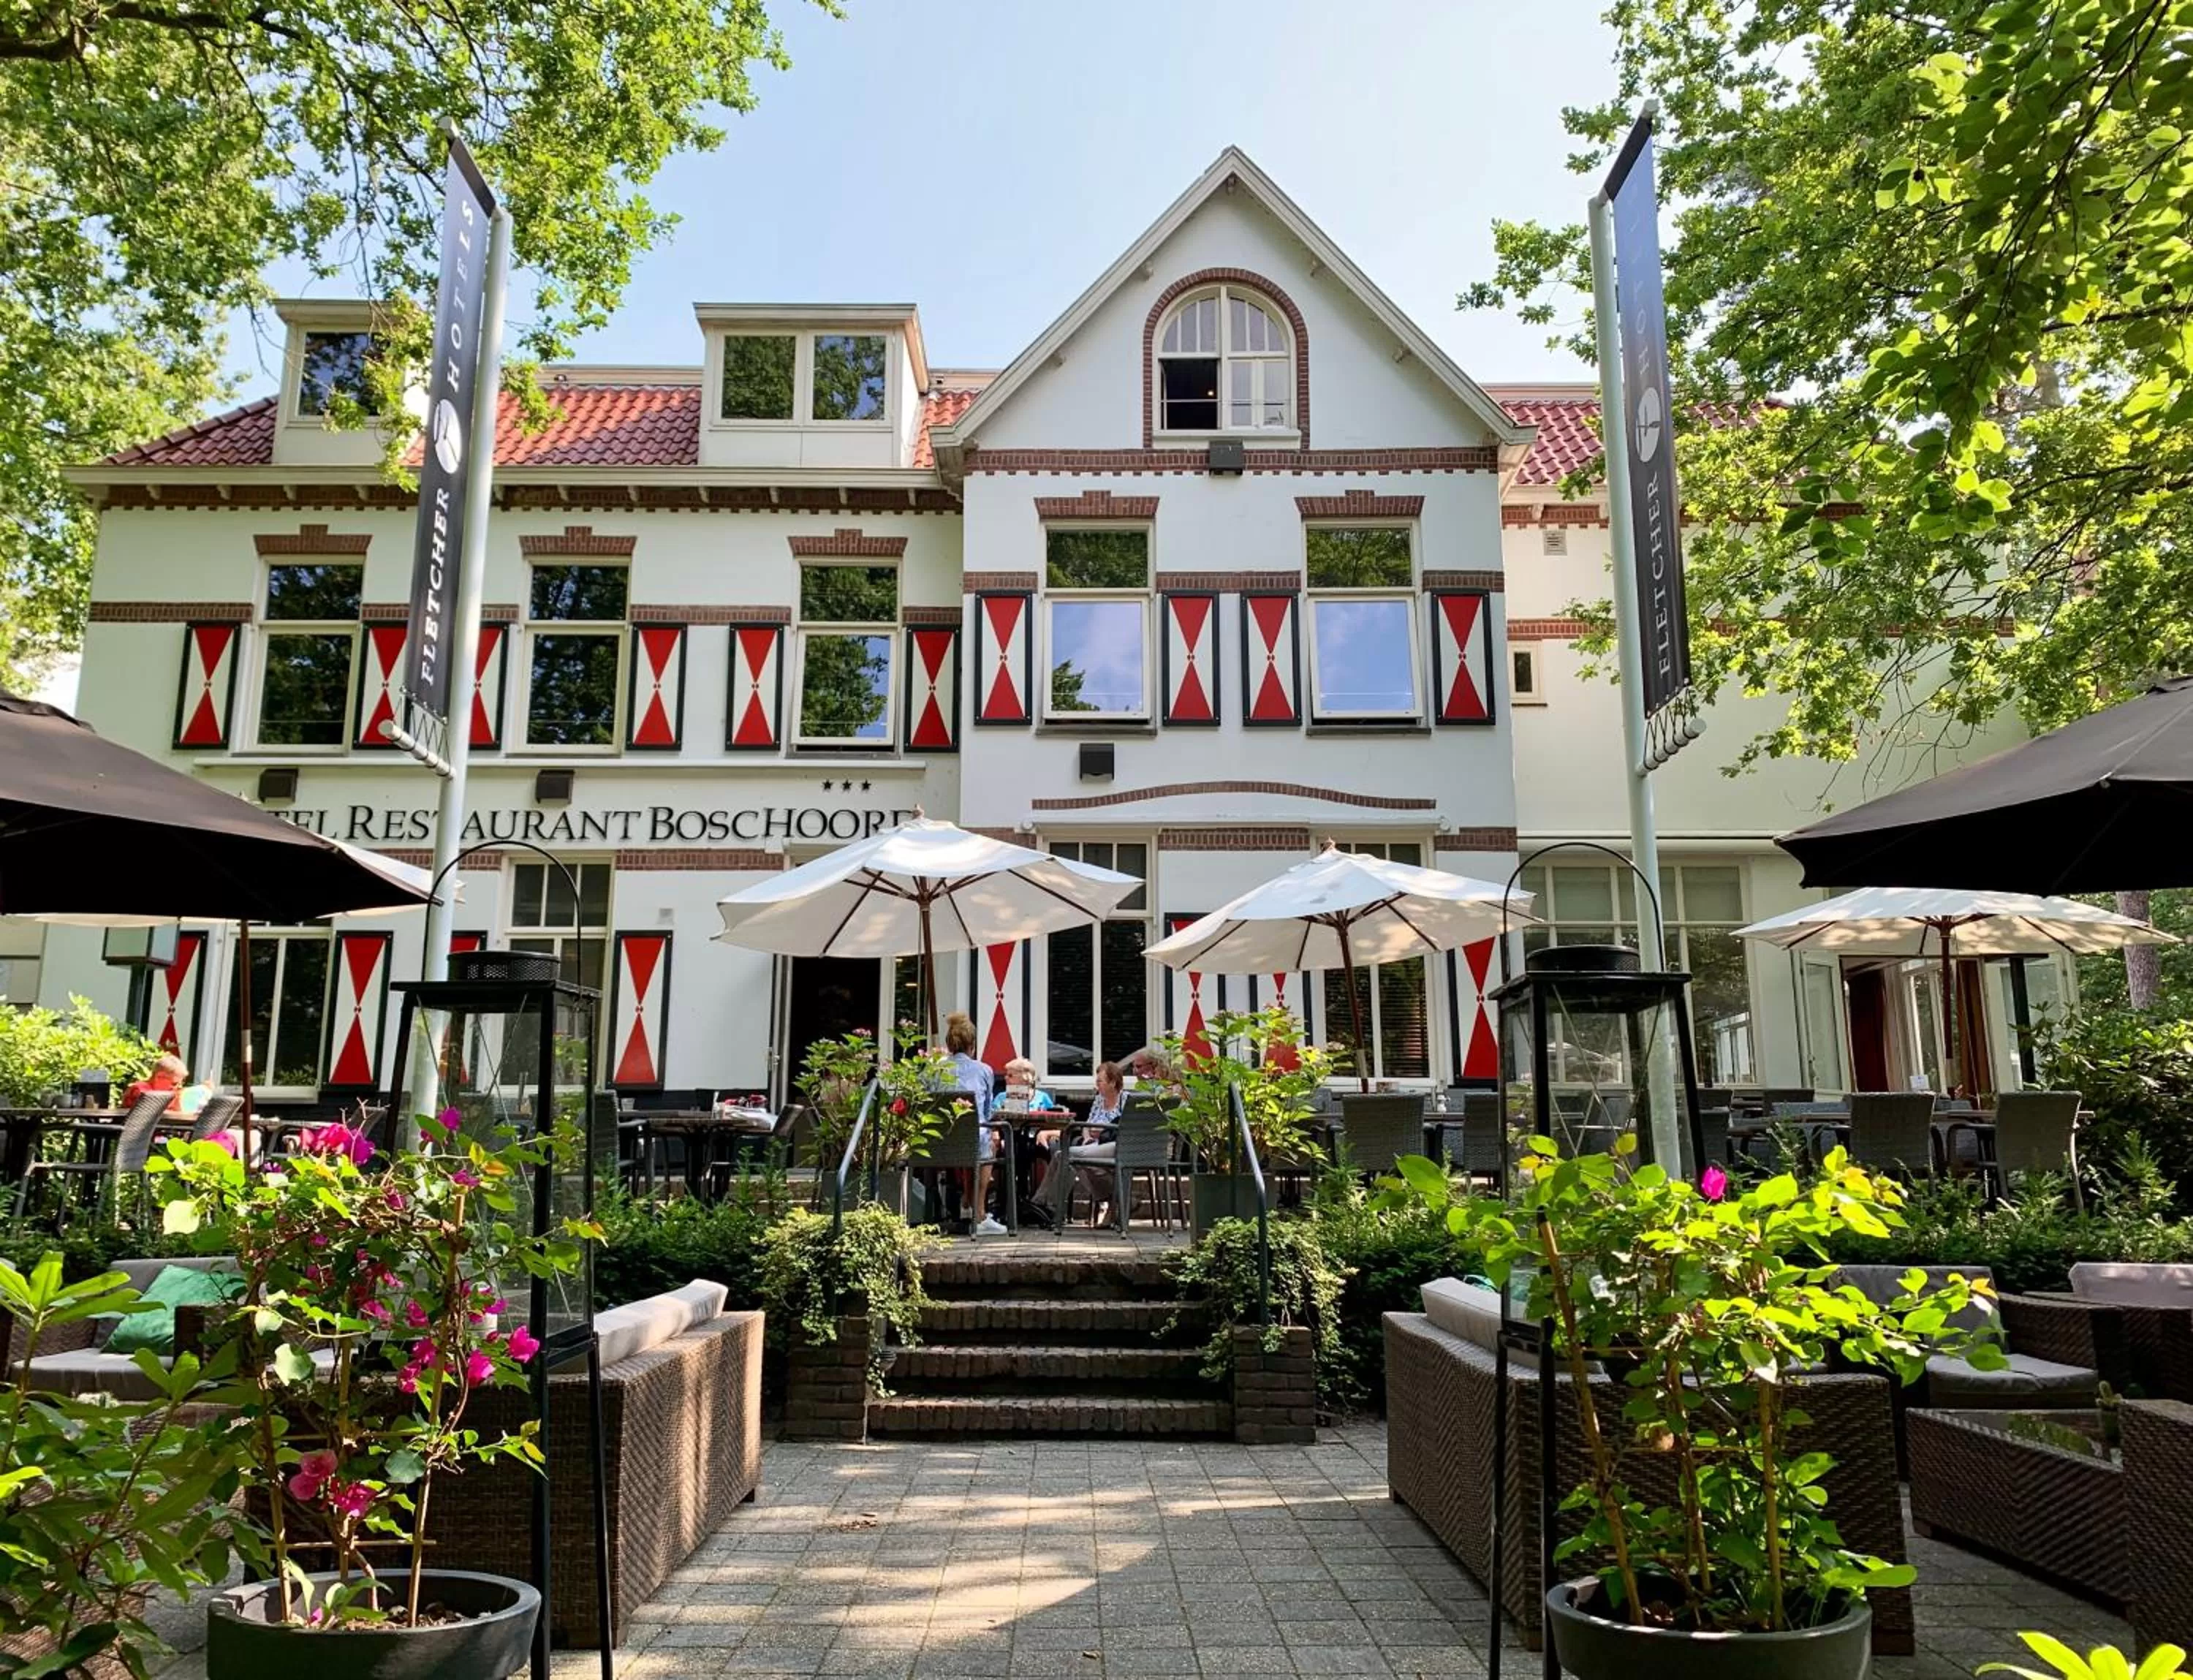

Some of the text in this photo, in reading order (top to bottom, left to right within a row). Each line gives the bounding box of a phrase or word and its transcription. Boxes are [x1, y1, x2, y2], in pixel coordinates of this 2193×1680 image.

[420, 199, 474, 687] FLETCHER HOTELS
[1647, 471, 1671, 679] FLETCHER
[344, 804, 642, 841] RESAURANT
